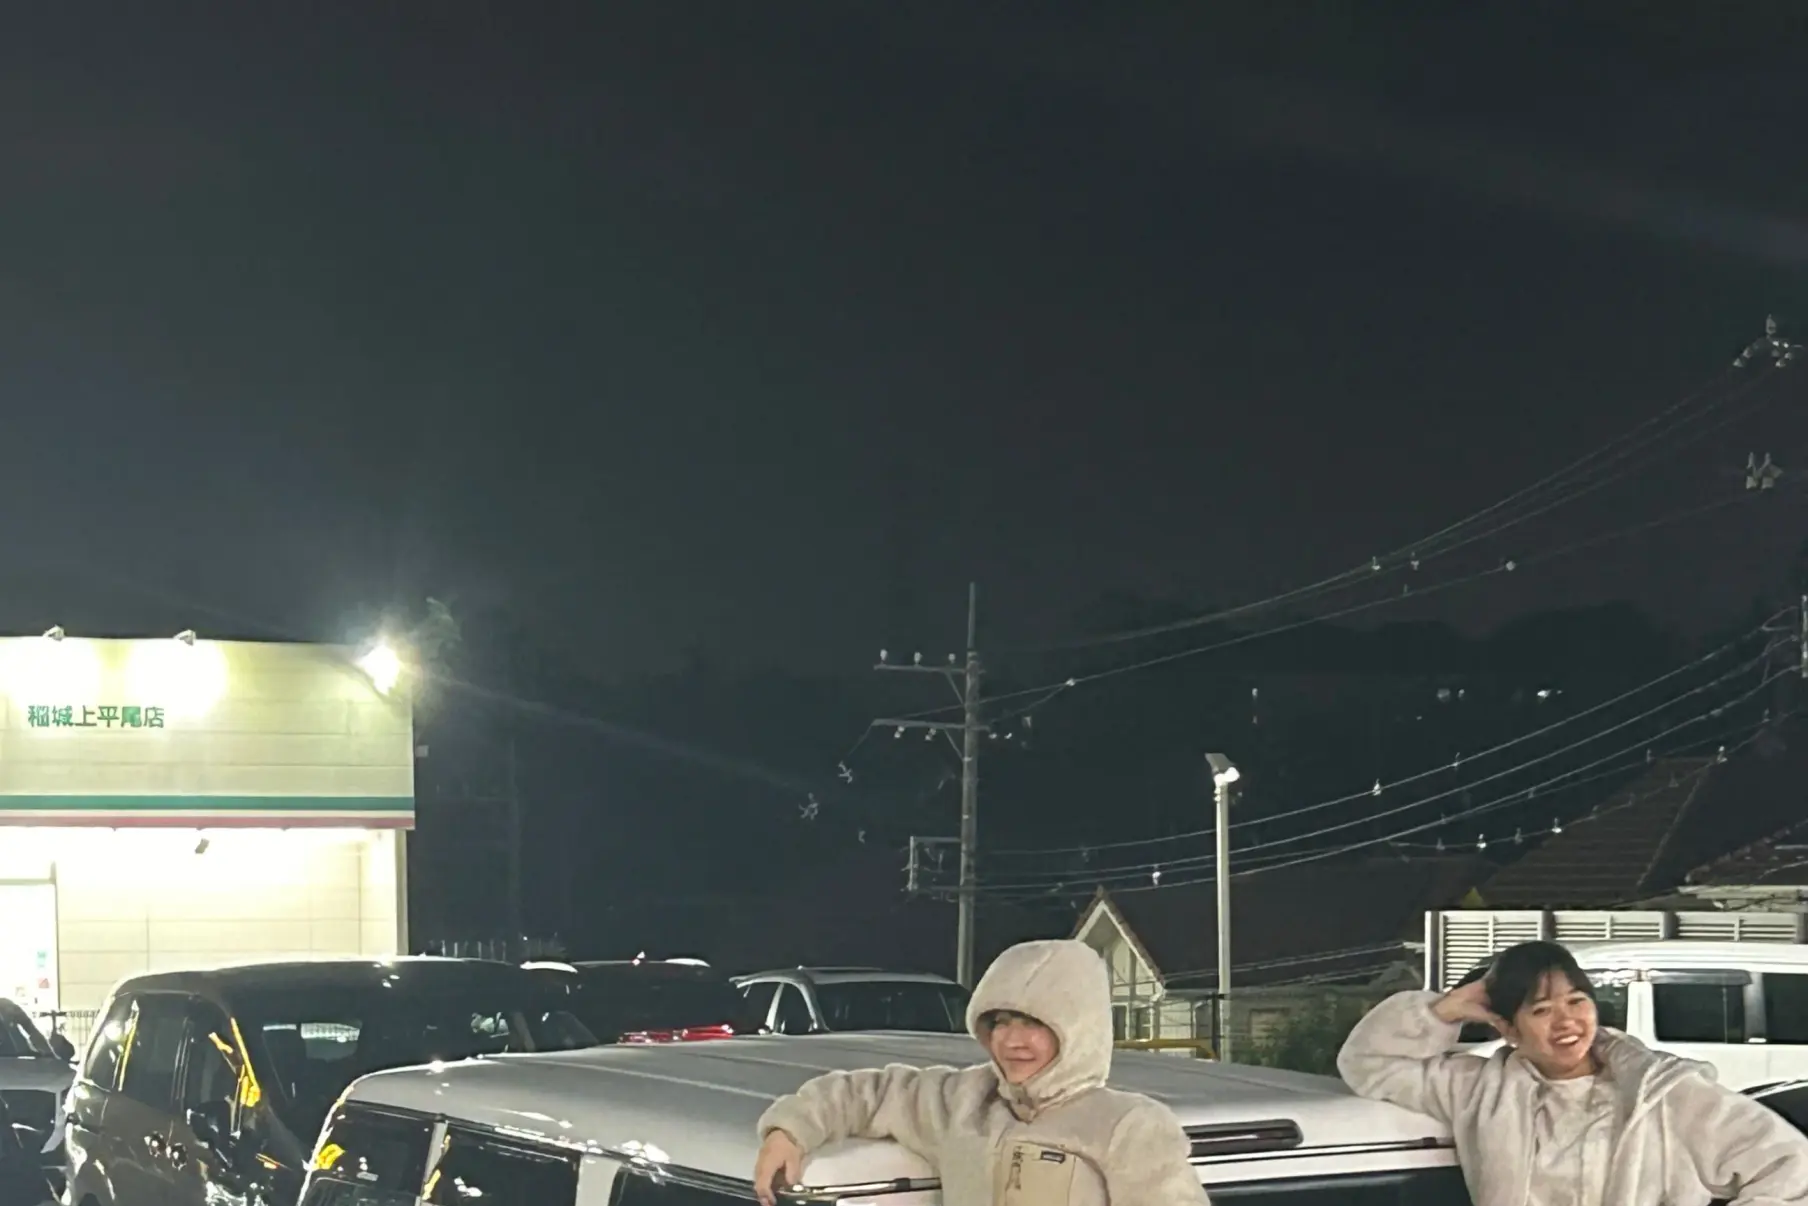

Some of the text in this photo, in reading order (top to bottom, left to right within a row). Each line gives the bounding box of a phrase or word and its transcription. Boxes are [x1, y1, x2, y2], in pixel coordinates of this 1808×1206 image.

[27, 704, 165, 729] 稲城上平尾店
